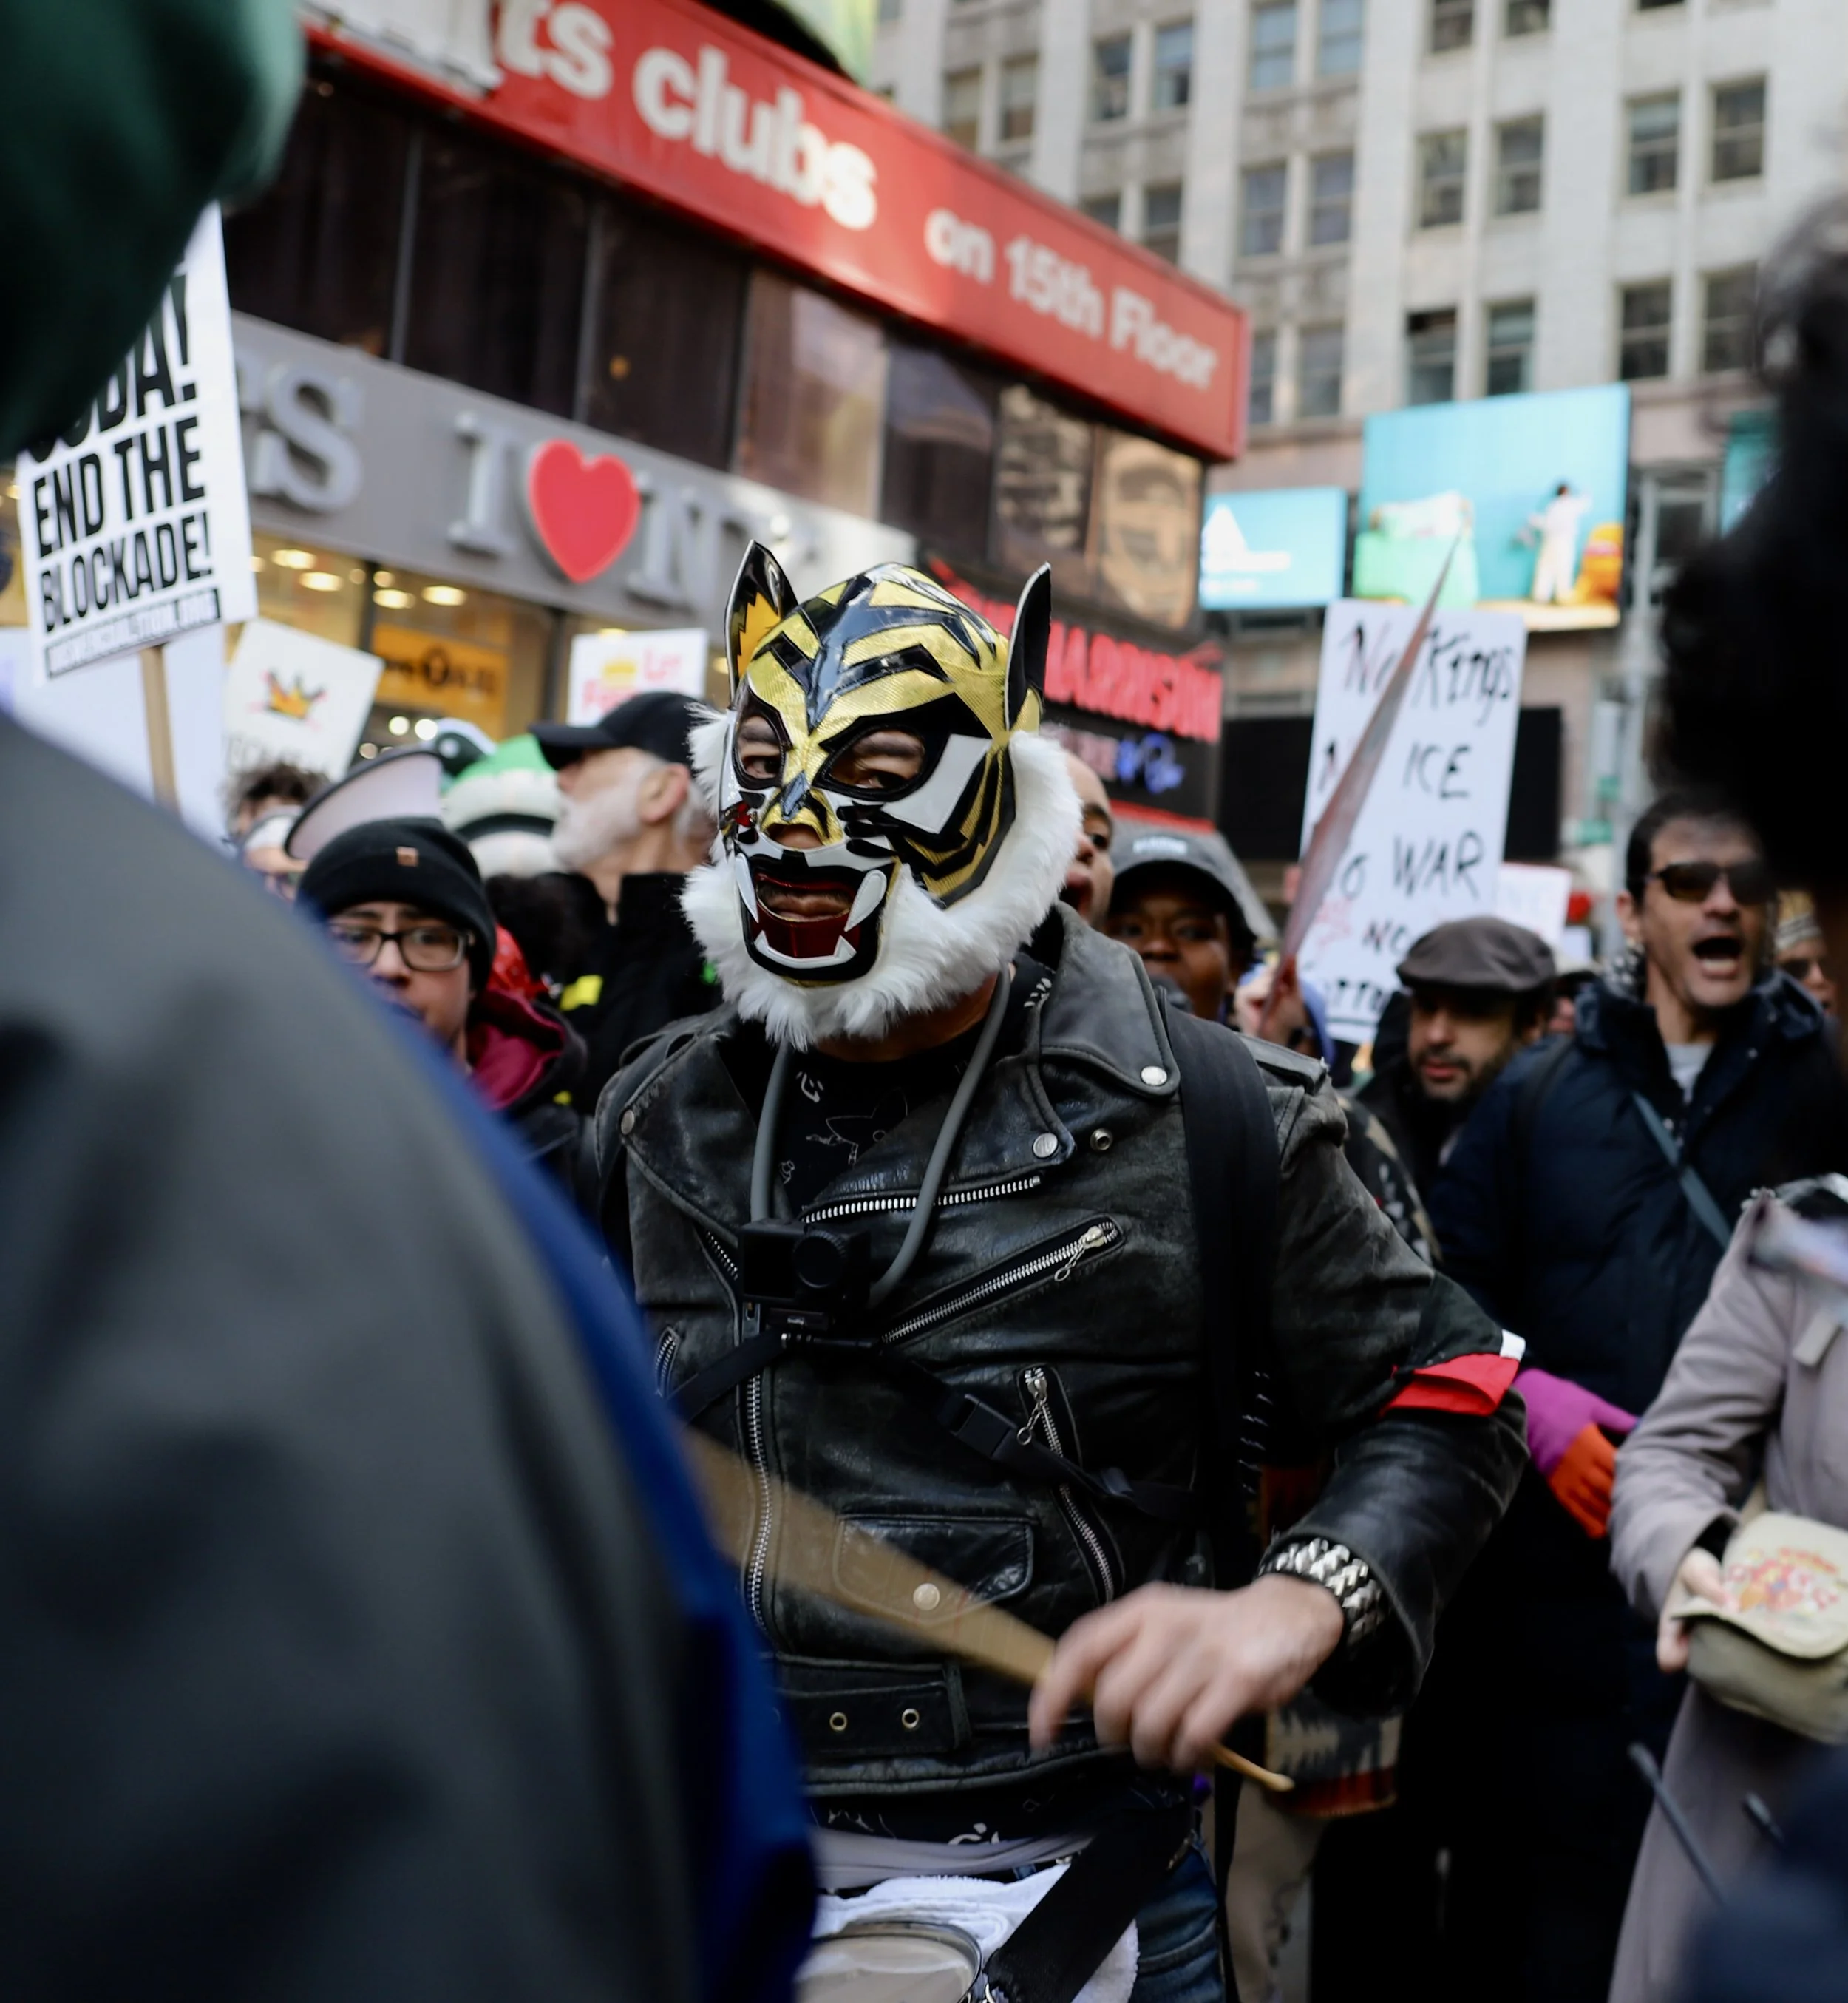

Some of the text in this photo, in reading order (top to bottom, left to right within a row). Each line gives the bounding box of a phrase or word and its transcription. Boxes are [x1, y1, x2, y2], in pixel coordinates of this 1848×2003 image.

[632, 46, 878, 230] clubs
[923, 208, 996, 283] on
[1005, 235, 1104, 339] 15th
[1112, 287, 1218, 389] Floor
[33, 416, 205, 560] END THE
[41, 512, 213, 633] BLOCKADE!
[1410, 626, 1515, 727] Kings
[1402, 739, 1472, 800] ICE
[1392, 830, 1487, 902] WAR
